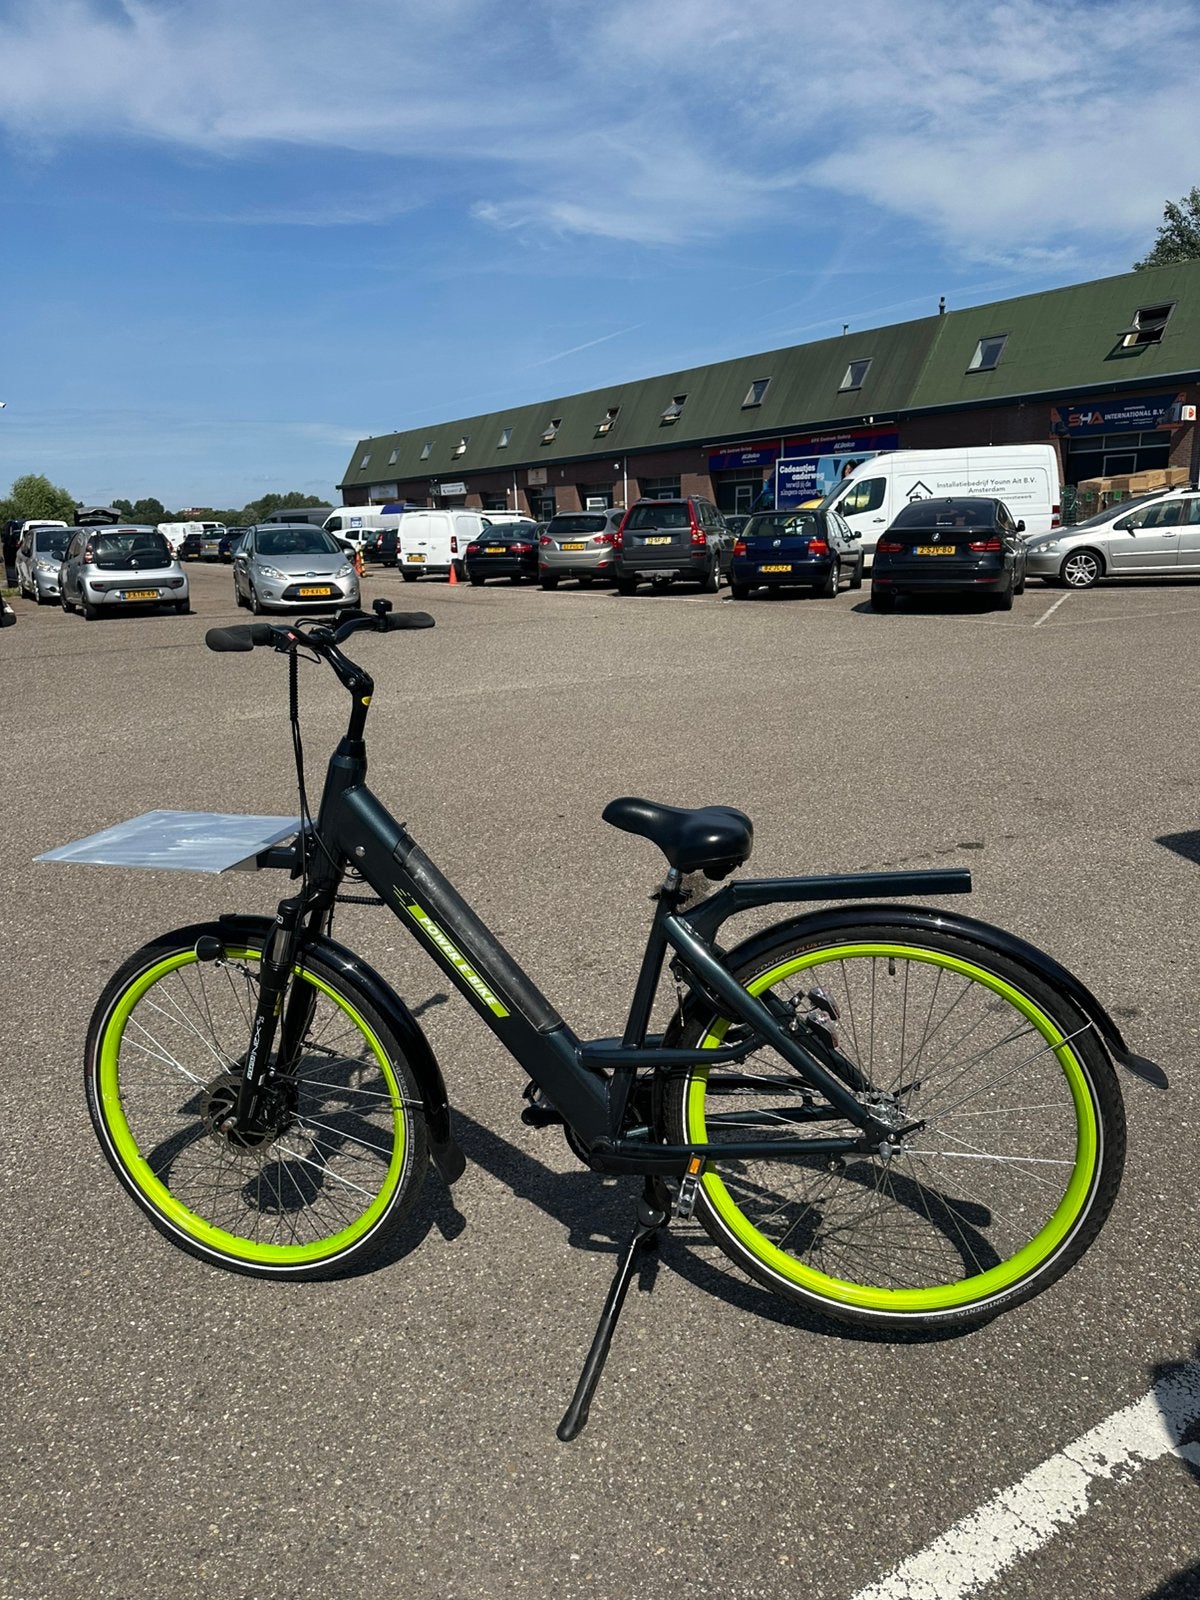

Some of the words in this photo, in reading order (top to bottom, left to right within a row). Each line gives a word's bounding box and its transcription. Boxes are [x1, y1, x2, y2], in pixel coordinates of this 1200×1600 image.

[1068, 411, 1104, 427] SHA
[1104, 409, 1151, 420] INTERNATIONAL
[1152, 408, 1165, 416] B.V.
[779, 463, 816, 474] Cadeautjes
[792, 472, 825, 482] onderweg
[805, 480, 812, 488] de
[936, 479, 989, 488] Installatiebedrijf
[968, 486, 1006, 494] Amsterdam
[420, 918, 461, 961] POWER
[458, 963, 498, 1006] E-BIKE
[957, 1296, 1012, 1317] CONTINENTAL
